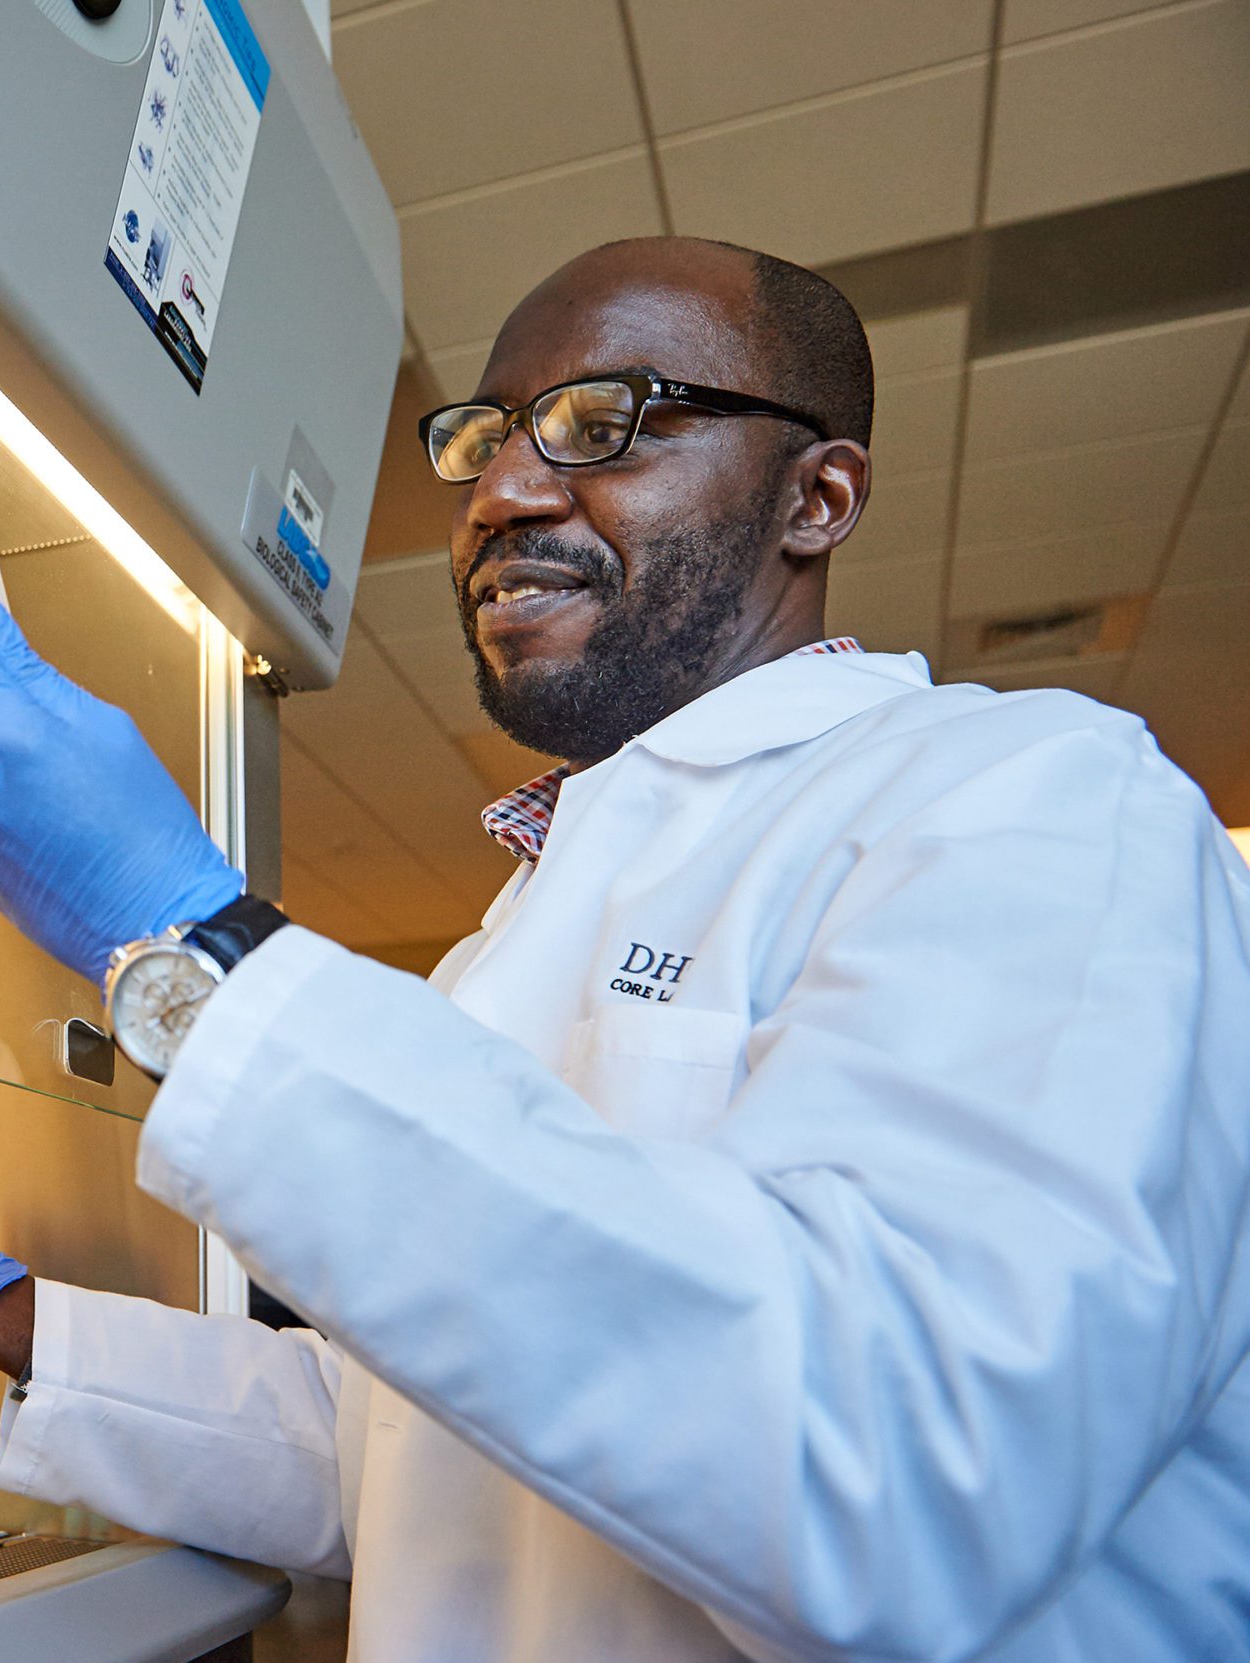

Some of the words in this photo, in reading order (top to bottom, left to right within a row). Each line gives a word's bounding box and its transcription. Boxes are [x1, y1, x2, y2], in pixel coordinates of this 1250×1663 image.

[256, 536, 291, 590] BIOLOGICAL
[291, 579, 312, 613] SAFETY
[619, 942, 694, 983] DH
[610, 978, 654, 999] CORE
[657, 990, 675, 1002] L
